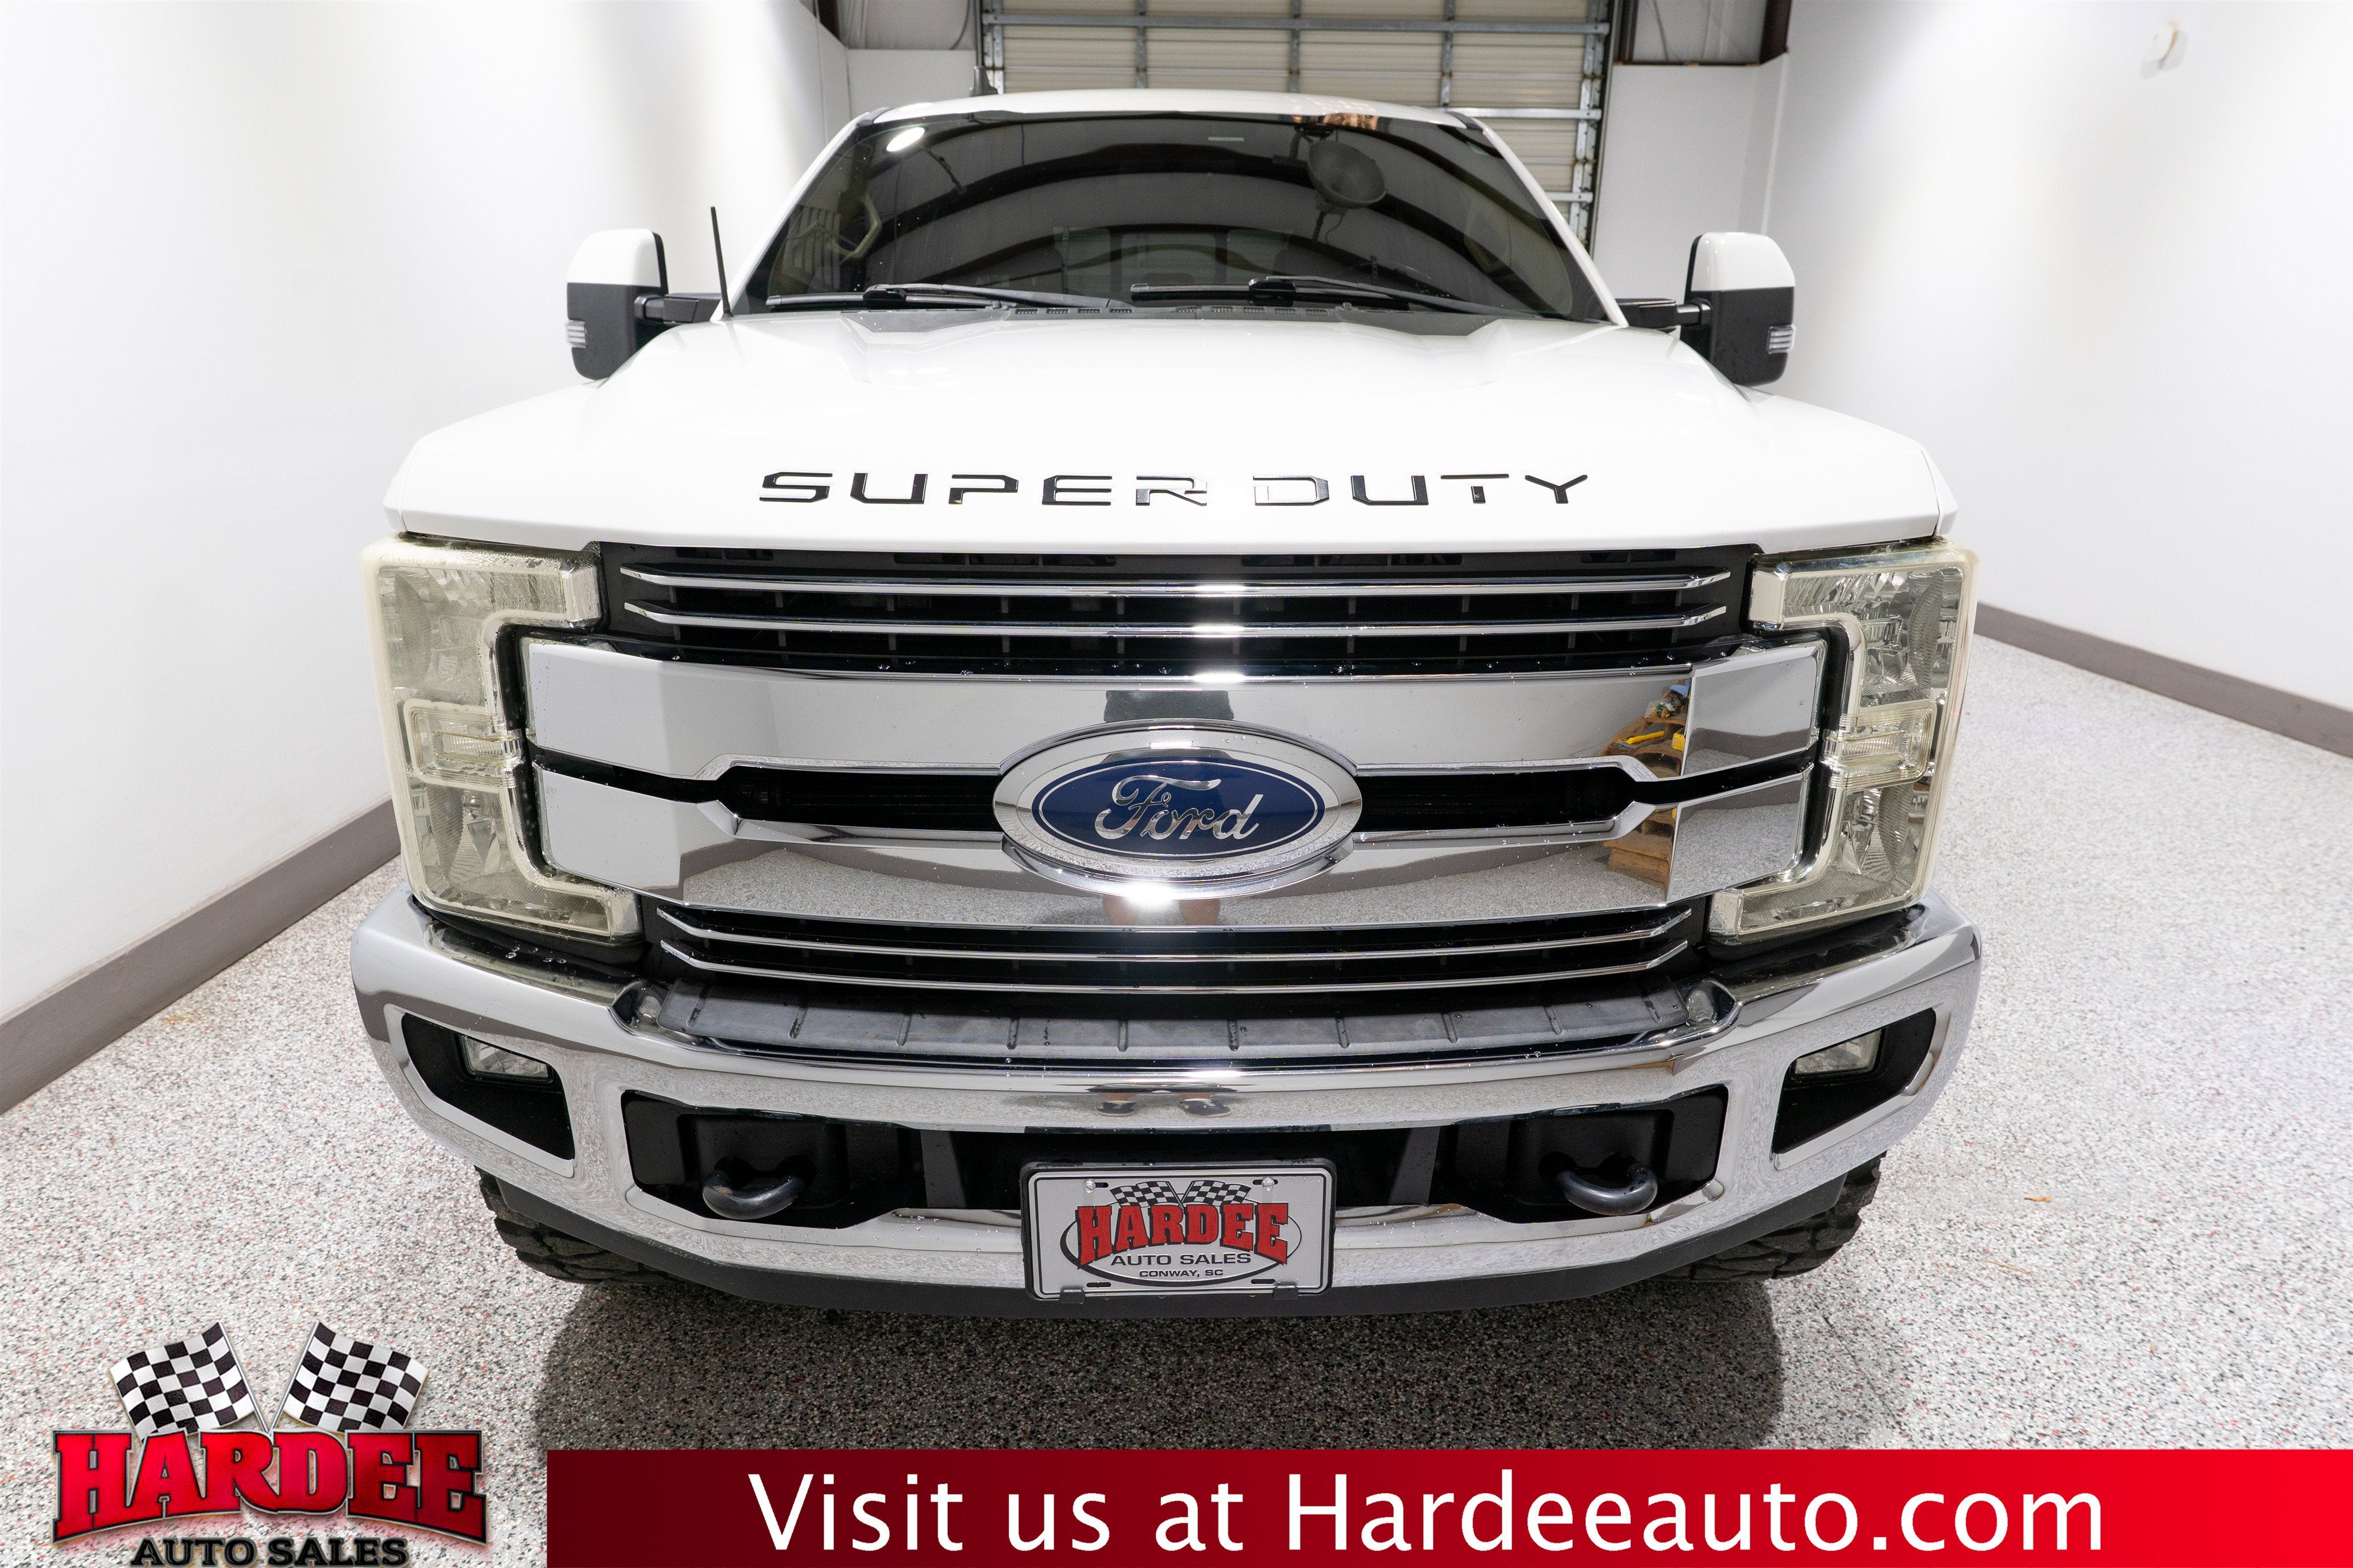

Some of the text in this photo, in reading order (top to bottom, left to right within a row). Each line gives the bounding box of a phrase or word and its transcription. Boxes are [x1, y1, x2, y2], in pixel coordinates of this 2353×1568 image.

[759, 472, 1588, 507] SUPER DUTY
[1094, 774, 1263, 840] Ford
[1075, 1202, 1289, 1269] HARDEE
[1110, 1252, 1252, 1266] AUTO SALES
[1139, 1269, 1224, 1278] CONWAY, SC
